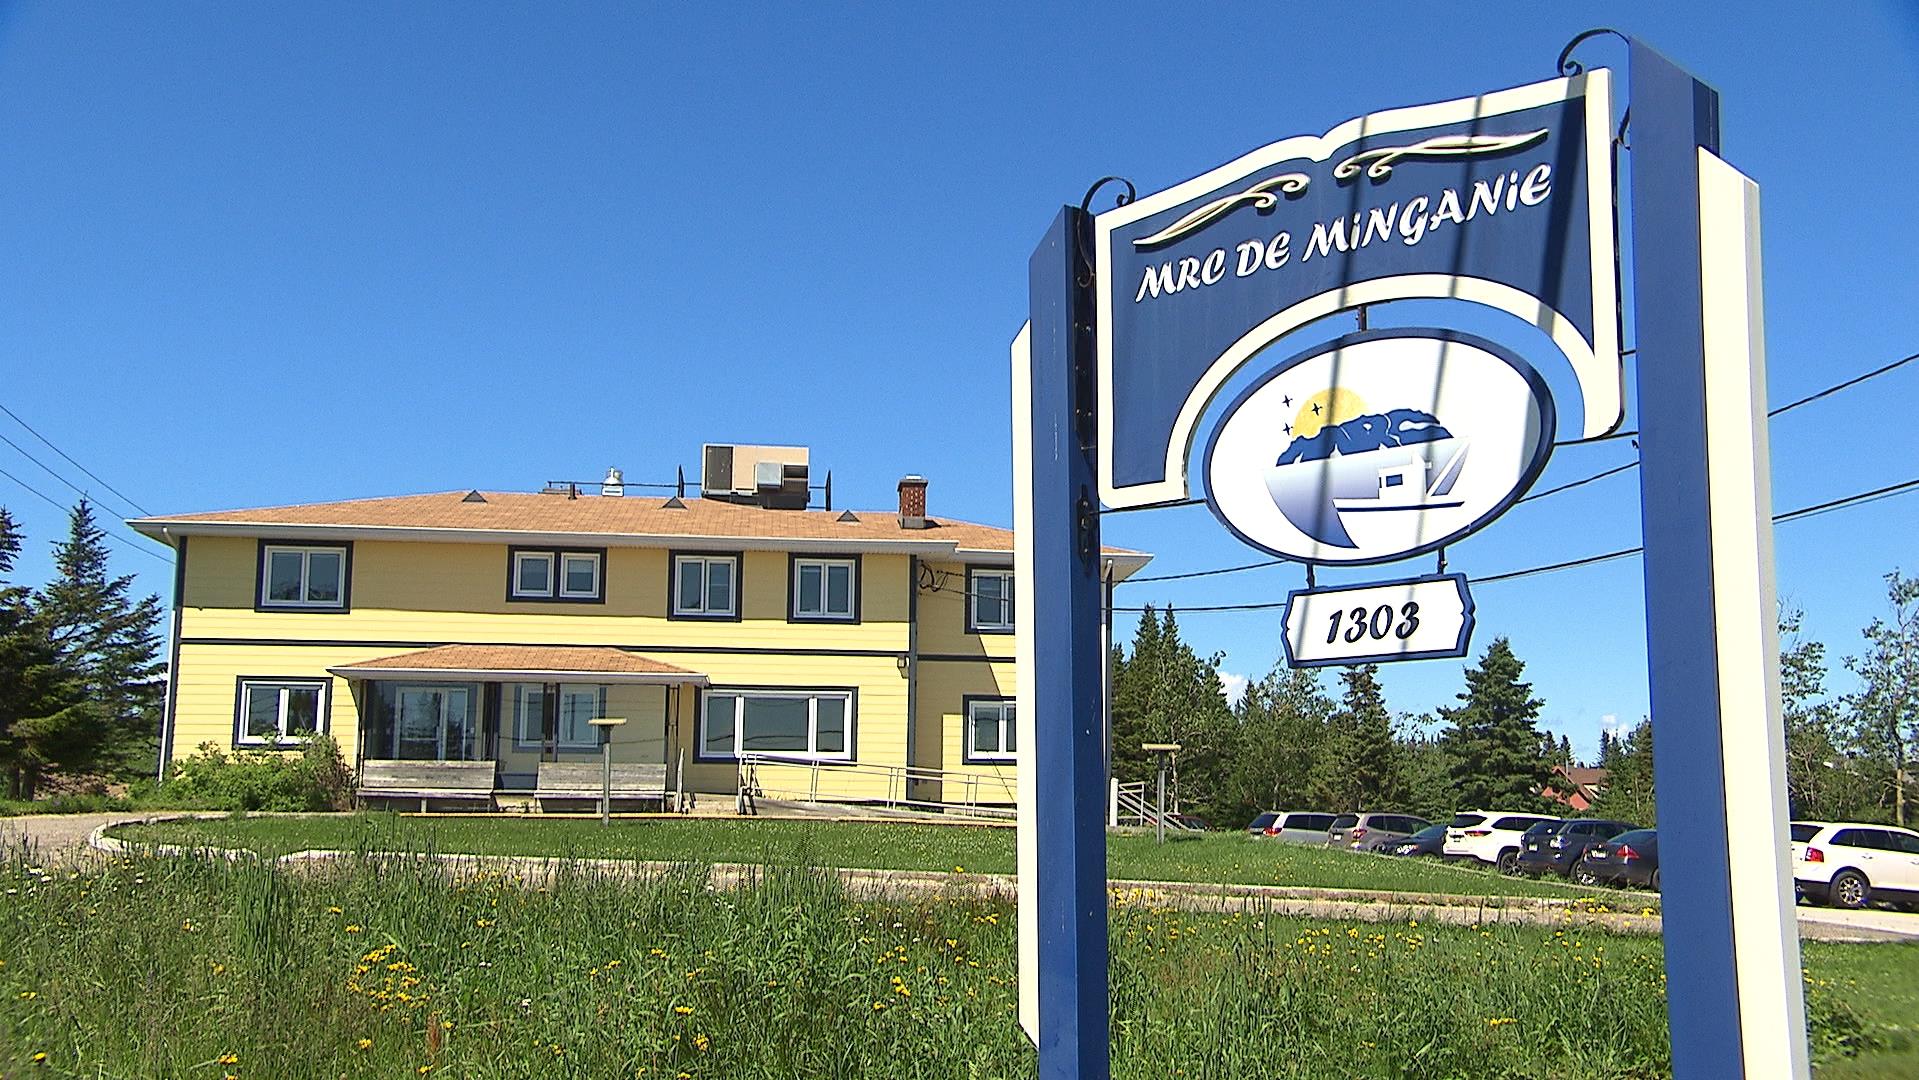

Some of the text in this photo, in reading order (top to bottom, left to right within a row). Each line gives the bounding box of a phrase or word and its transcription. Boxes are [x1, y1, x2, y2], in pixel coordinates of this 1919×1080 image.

[1136, 249, 1225, 302] MRC
[1236, 231, 1290, 276] DE
[1327, 601, 1420, 644] 1303
